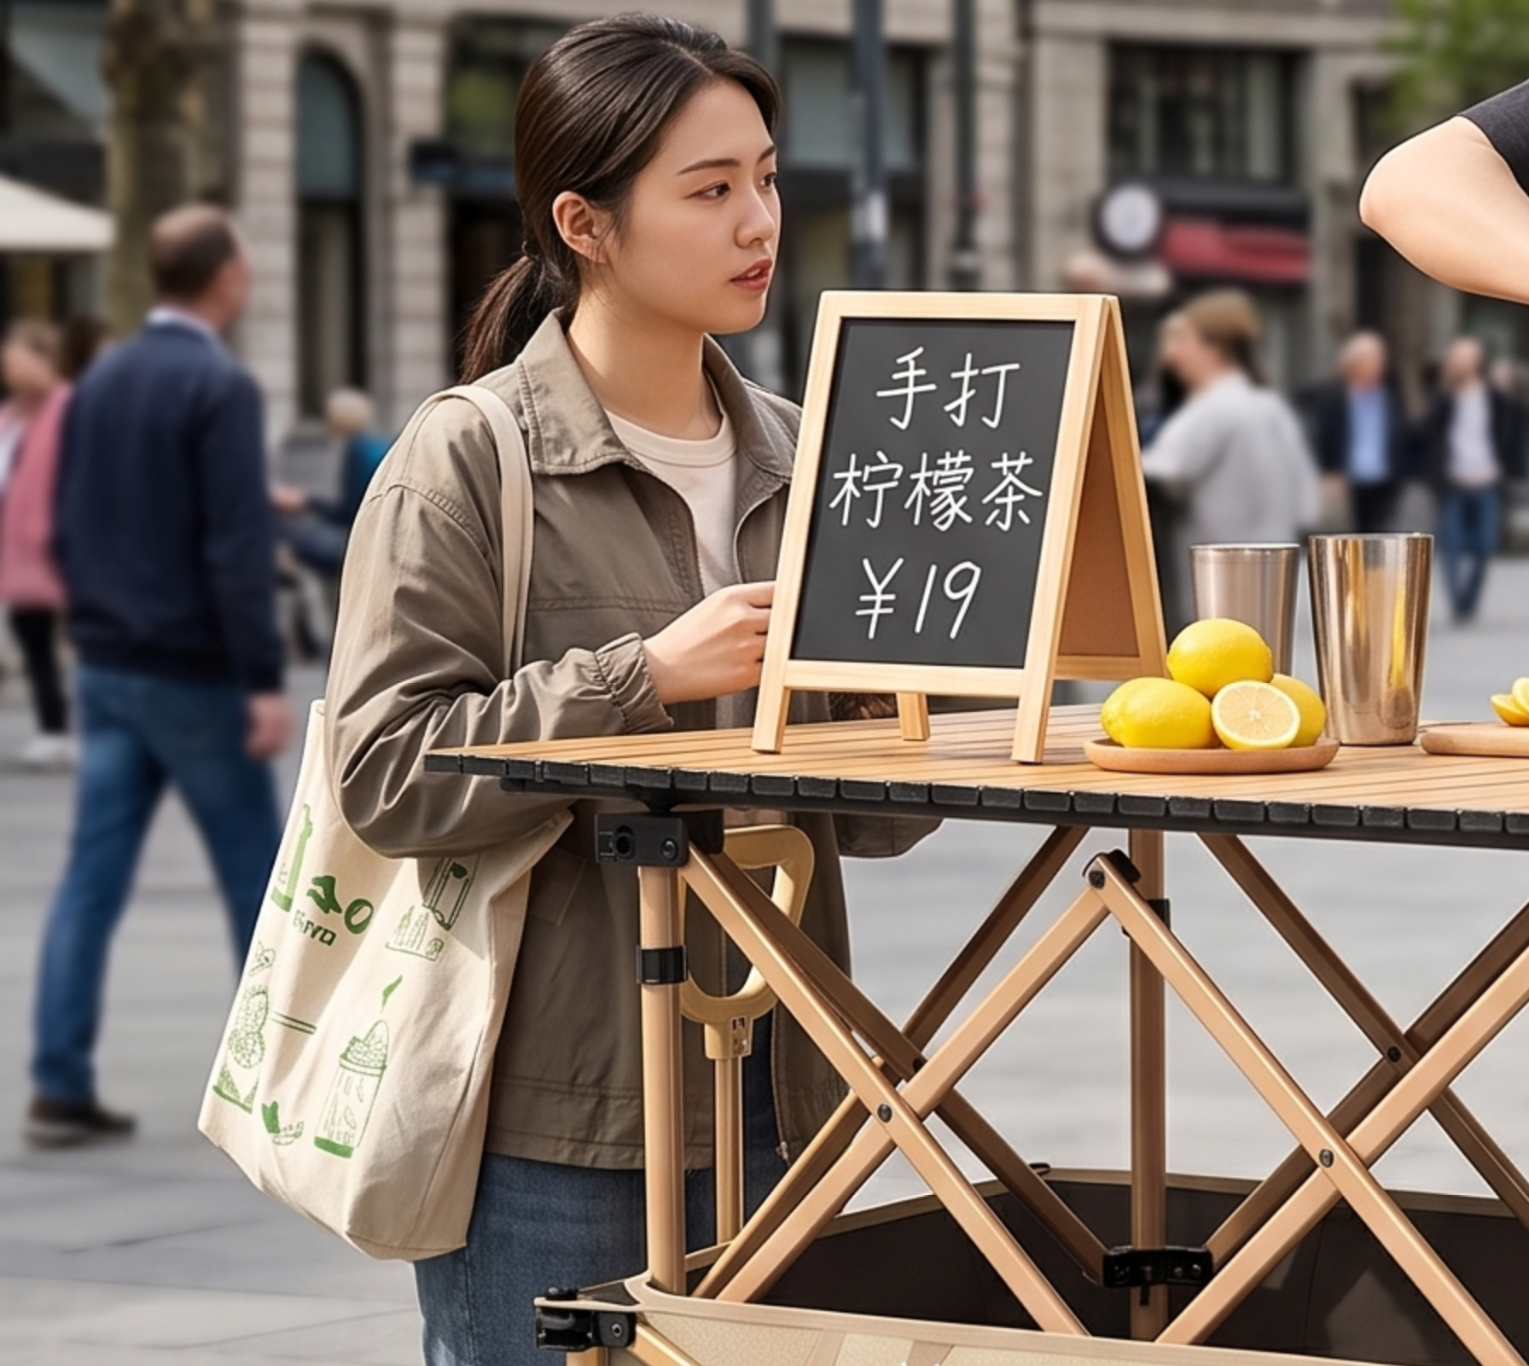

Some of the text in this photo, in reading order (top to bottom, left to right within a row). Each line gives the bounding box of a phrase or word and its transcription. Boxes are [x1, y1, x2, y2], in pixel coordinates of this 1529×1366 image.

[876, 346, 1021, 430] 手打
[828, 449, 1043, 532] 柠檬茶
[855, 557, 982, 640] ¥19
